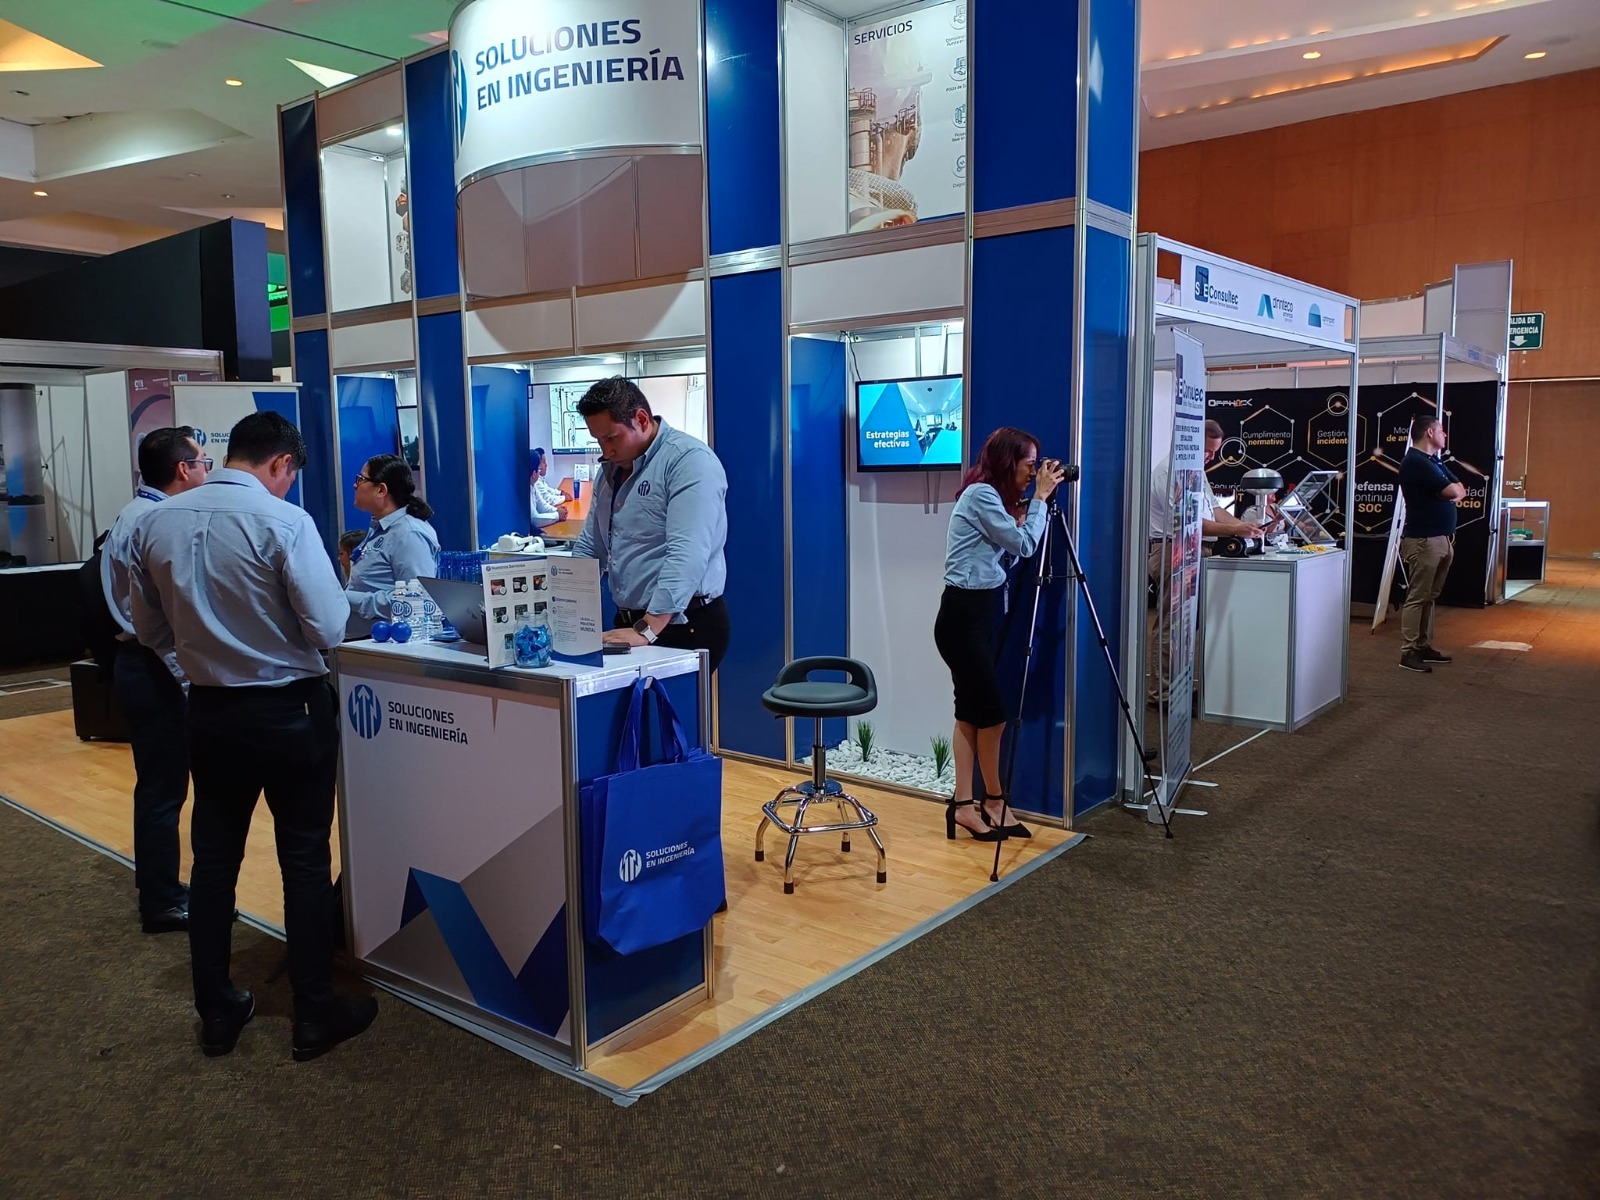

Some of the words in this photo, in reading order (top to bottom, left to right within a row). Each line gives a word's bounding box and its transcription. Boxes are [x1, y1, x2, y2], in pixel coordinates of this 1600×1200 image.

[854, 20, 913, 45] SERVICIOS
[475, 19, 641, 75] SOLUCIONES
[477, 80, 500, 110] EN
[508, 48, 685, 99] INGENIERÍA
[1510, 317, 1526, 325] ALIDA
[1527, 316, 1536, 324] DE
[1509, 326, 1539, 335] ERGENCIA
[866, 430, 910, 440] Estrategias
[1243, 430, 1291, 440] Cumplimiento
[1317, 429, 1346, 438] Gestión
[1386, 434, 1397, 442] de
[873, 439, 910, 448] efectivas
[1248, 438, 1285, 446] normativo
[1317, 437, 1348, 445] incident
[1355, 492, 1393, 502] ontinua
[1358, 503, 1382, 513] SOC
[388, 701, 454, 724] SOLUCIONES
[389, 717, 403, 731] EN
[406, 721, 468, 745] INGENIERÍA
[645, 841, 689, 859] SOLUCIONES
[646, 860, 656, 868] EN
[657, 847, 695, 865] INGENIERÍA
